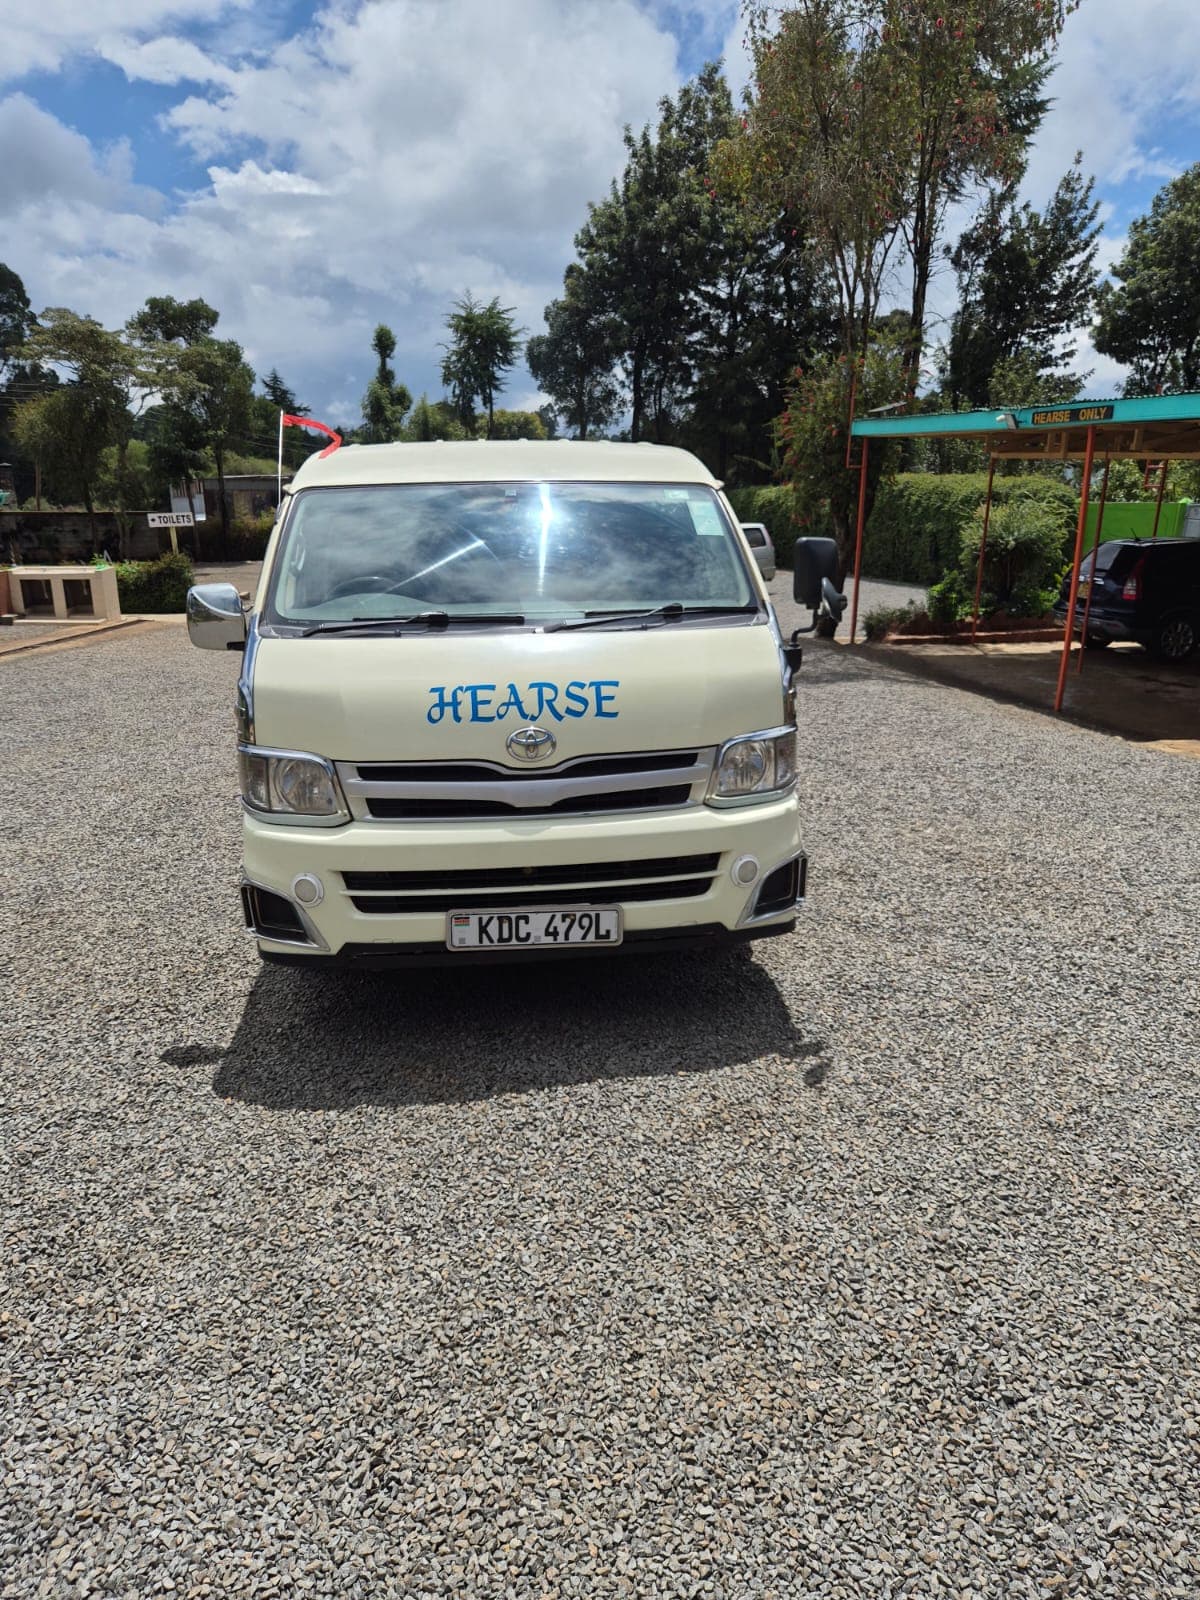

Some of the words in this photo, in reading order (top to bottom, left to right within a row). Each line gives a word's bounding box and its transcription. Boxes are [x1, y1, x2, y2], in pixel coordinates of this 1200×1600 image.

[1034, 410, 1071, 424] HEARSE
[1079, 407, 1107, 420] ONLY
[158, 515, 192, 524] TOILETS
[427, 680, 620, 724] HEARSE
[478, 915, 531, 944] KDC
[544, 912, 611, 942] 479L
